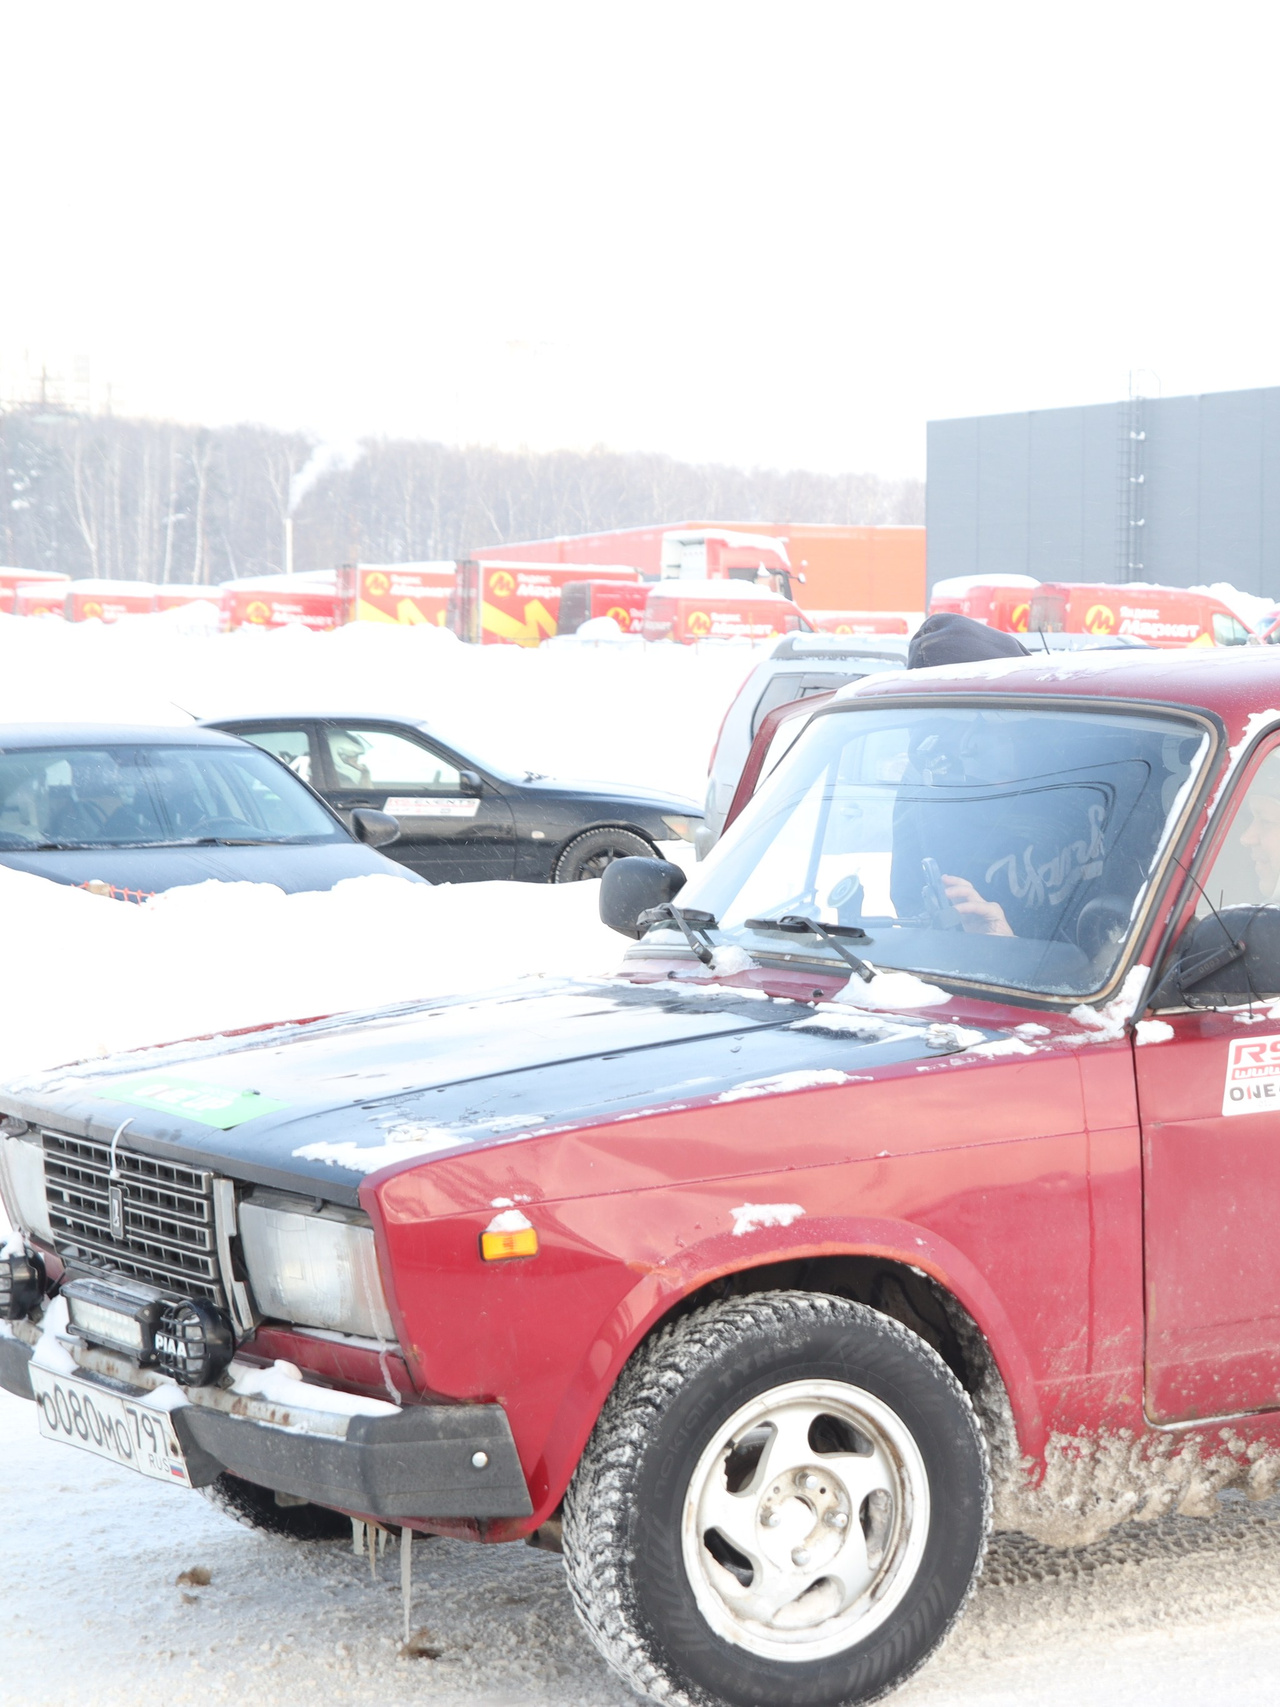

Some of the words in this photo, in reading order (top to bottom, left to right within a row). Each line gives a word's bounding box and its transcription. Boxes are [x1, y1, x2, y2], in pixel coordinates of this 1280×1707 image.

[1118, 619, 1200, 638] Маркет
[155, 1333, 187, 1358] PIAA
[127, 1407, 169, 1457] 797
[149, 1453, 171, 1473] RUS
